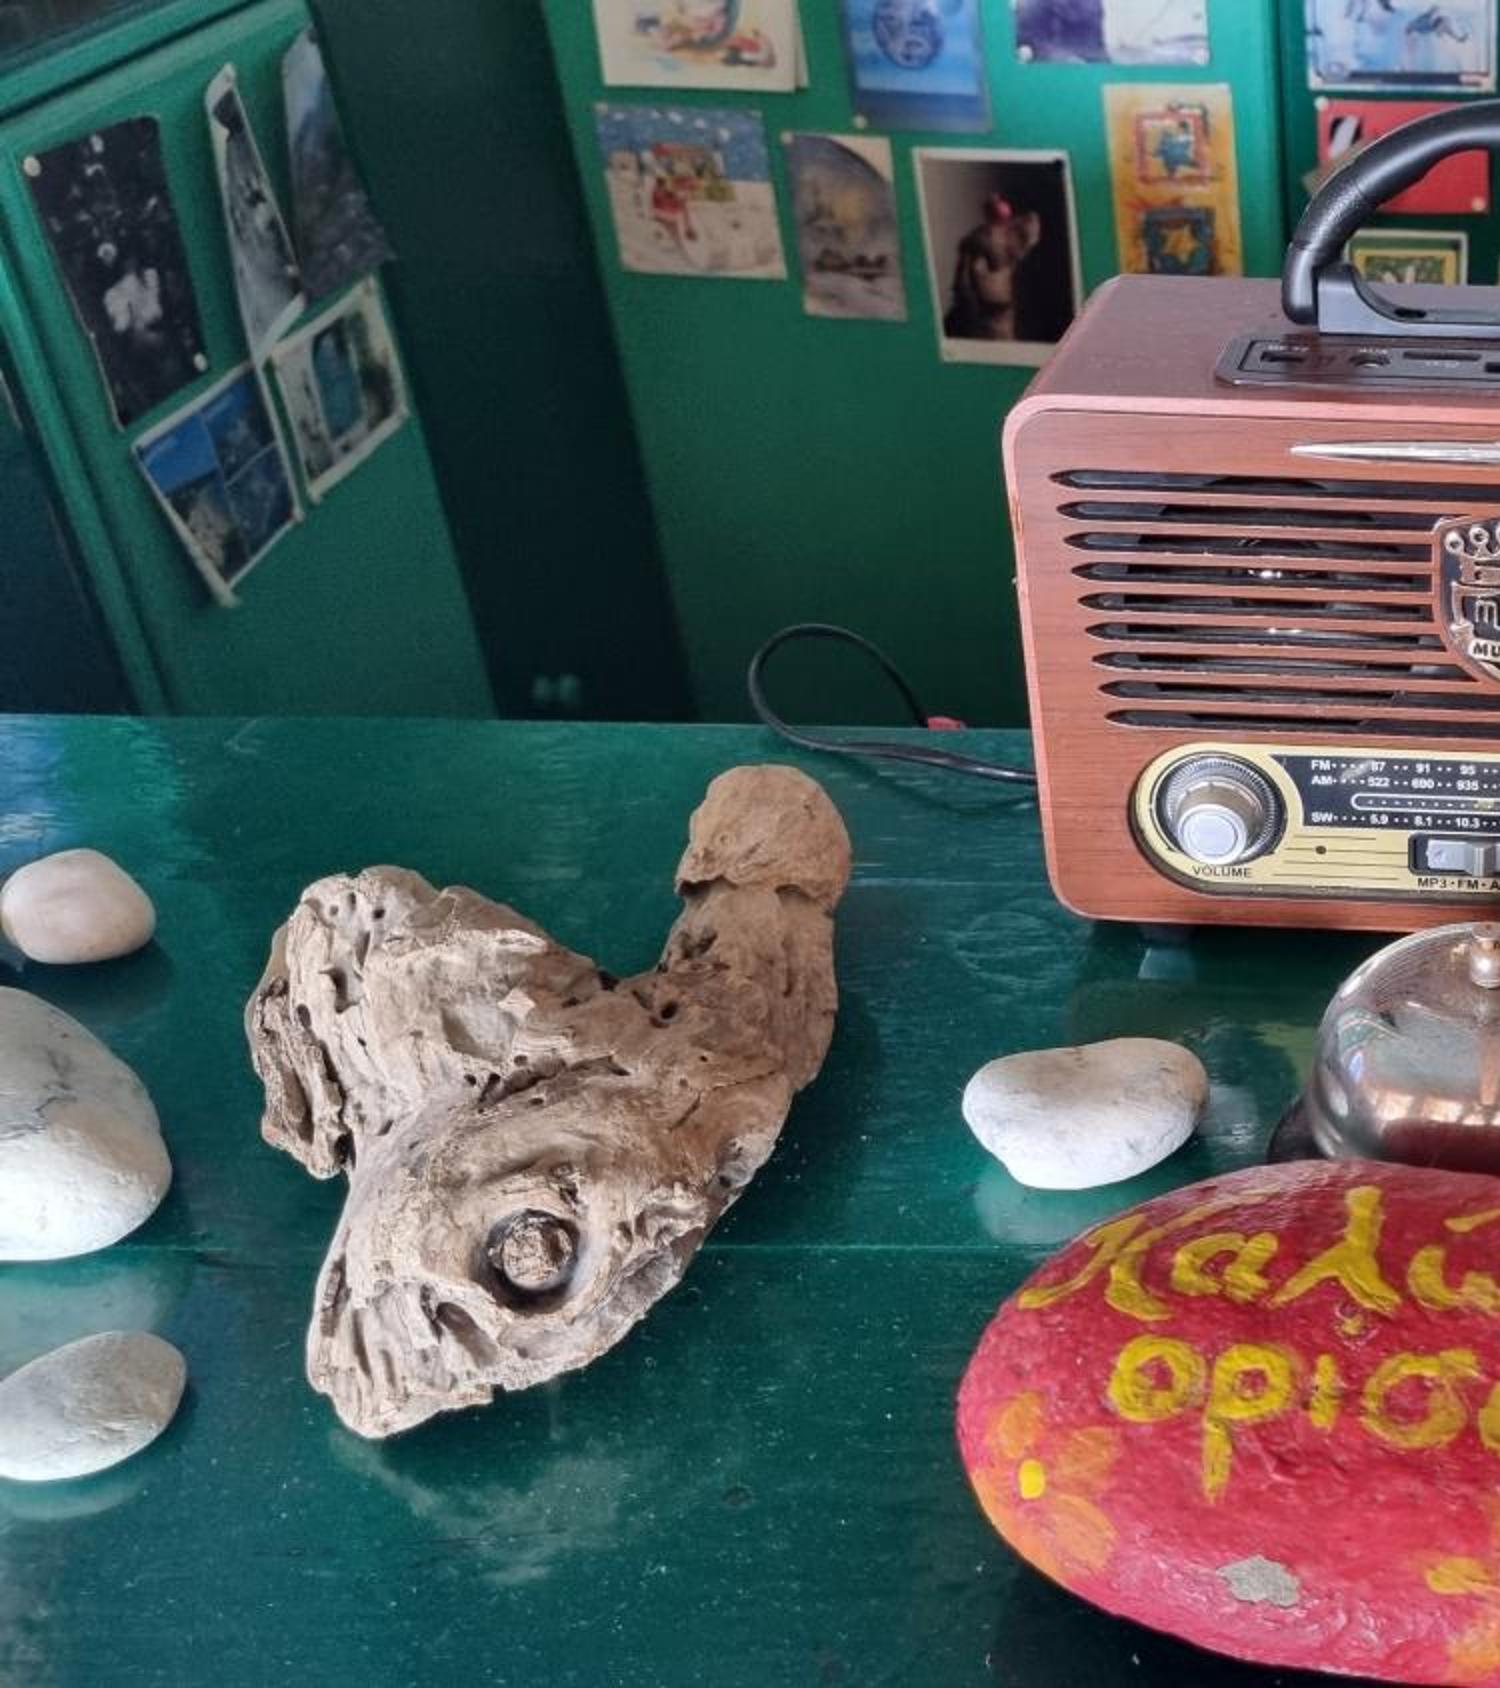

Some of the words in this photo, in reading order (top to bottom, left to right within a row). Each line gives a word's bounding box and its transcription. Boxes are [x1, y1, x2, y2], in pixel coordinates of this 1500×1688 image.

[1311, 759, 1331, 771] FM
[1416, 763, 1430, 773] 91
[1460, 765, 1476, 776] 95
[1311, 776, 1332, 785] AM
[1367, 777, 1390, 787] 522
[1311, 812, 1333, 823] SW
[1455, 817, 1481, 828] 10.3
[1192, 864, 1253, 878] VOLUME
[1418, 878, 1447, 889] MP3
